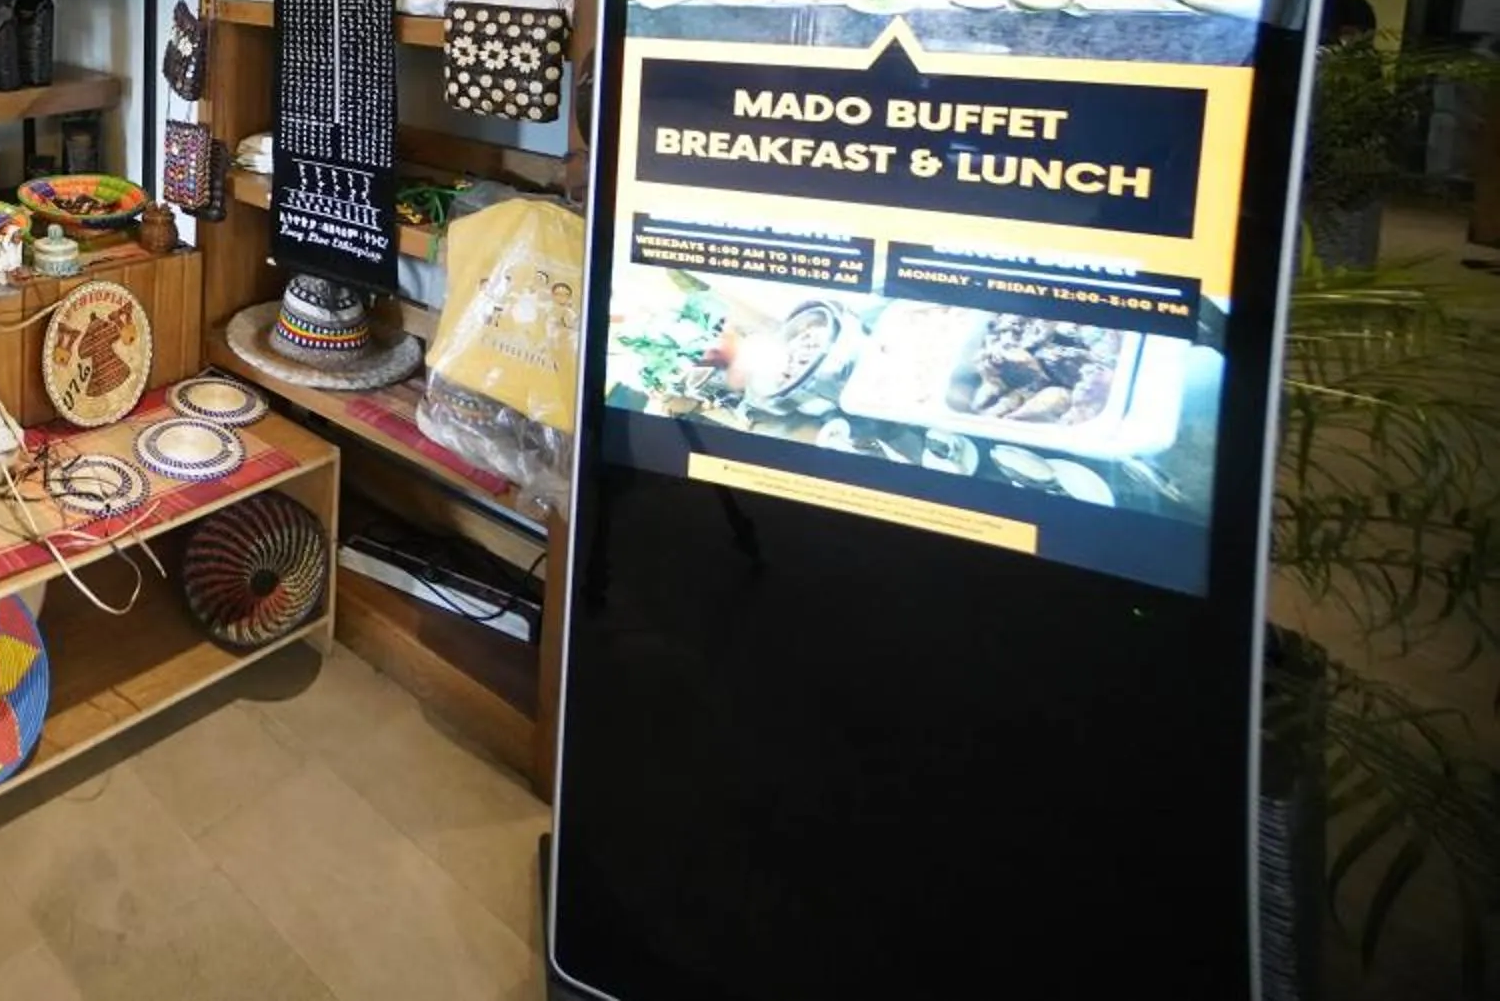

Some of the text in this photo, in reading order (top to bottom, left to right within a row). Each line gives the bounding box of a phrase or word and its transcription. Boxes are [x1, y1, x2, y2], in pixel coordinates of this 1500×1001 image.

[733, 88, 1068, 141] MADO BUFFET
[655, 127, 1152, 199] BREAKFAST & LUNCH
[635, 234, 705, 252] WEEKDAYS
[743, 248, 765, 261] AM
[768, 251, 788, 263] TO
[839, 260, 864, 272] AM
[641, 248, 705, 265] WEEKEND
[743, 260, 765, 273] AM
[768, 264, 788, 275] TO
[833, 272, 859, 285] AM
[897, 267, 970, 287] MONDAY
[987, 278, 1049, 297] FRIDAY
[1157, 301, 1189, 317] PM
